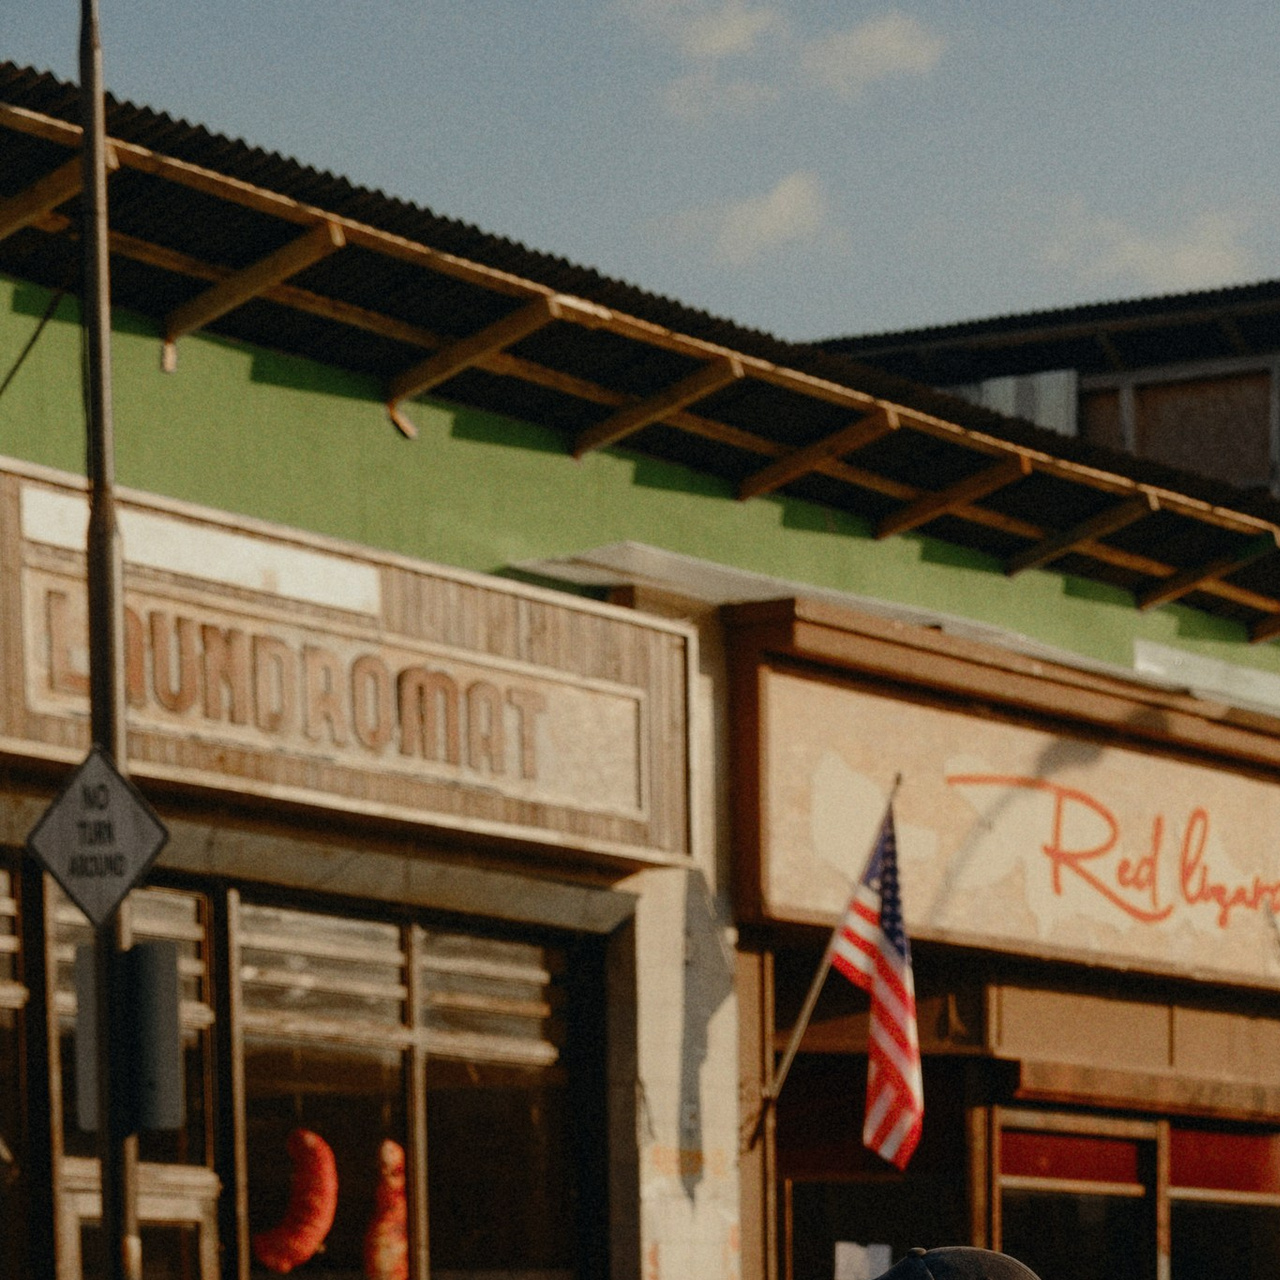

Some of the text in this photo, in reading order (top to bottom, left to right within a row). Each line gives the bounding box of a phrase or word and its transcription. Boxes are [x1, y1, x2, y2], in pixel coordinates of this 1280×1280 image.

[81, 783, 110, 812] NO
[77, 820, 116, 845] TURN
[947, 774, 1174, 924] Red
